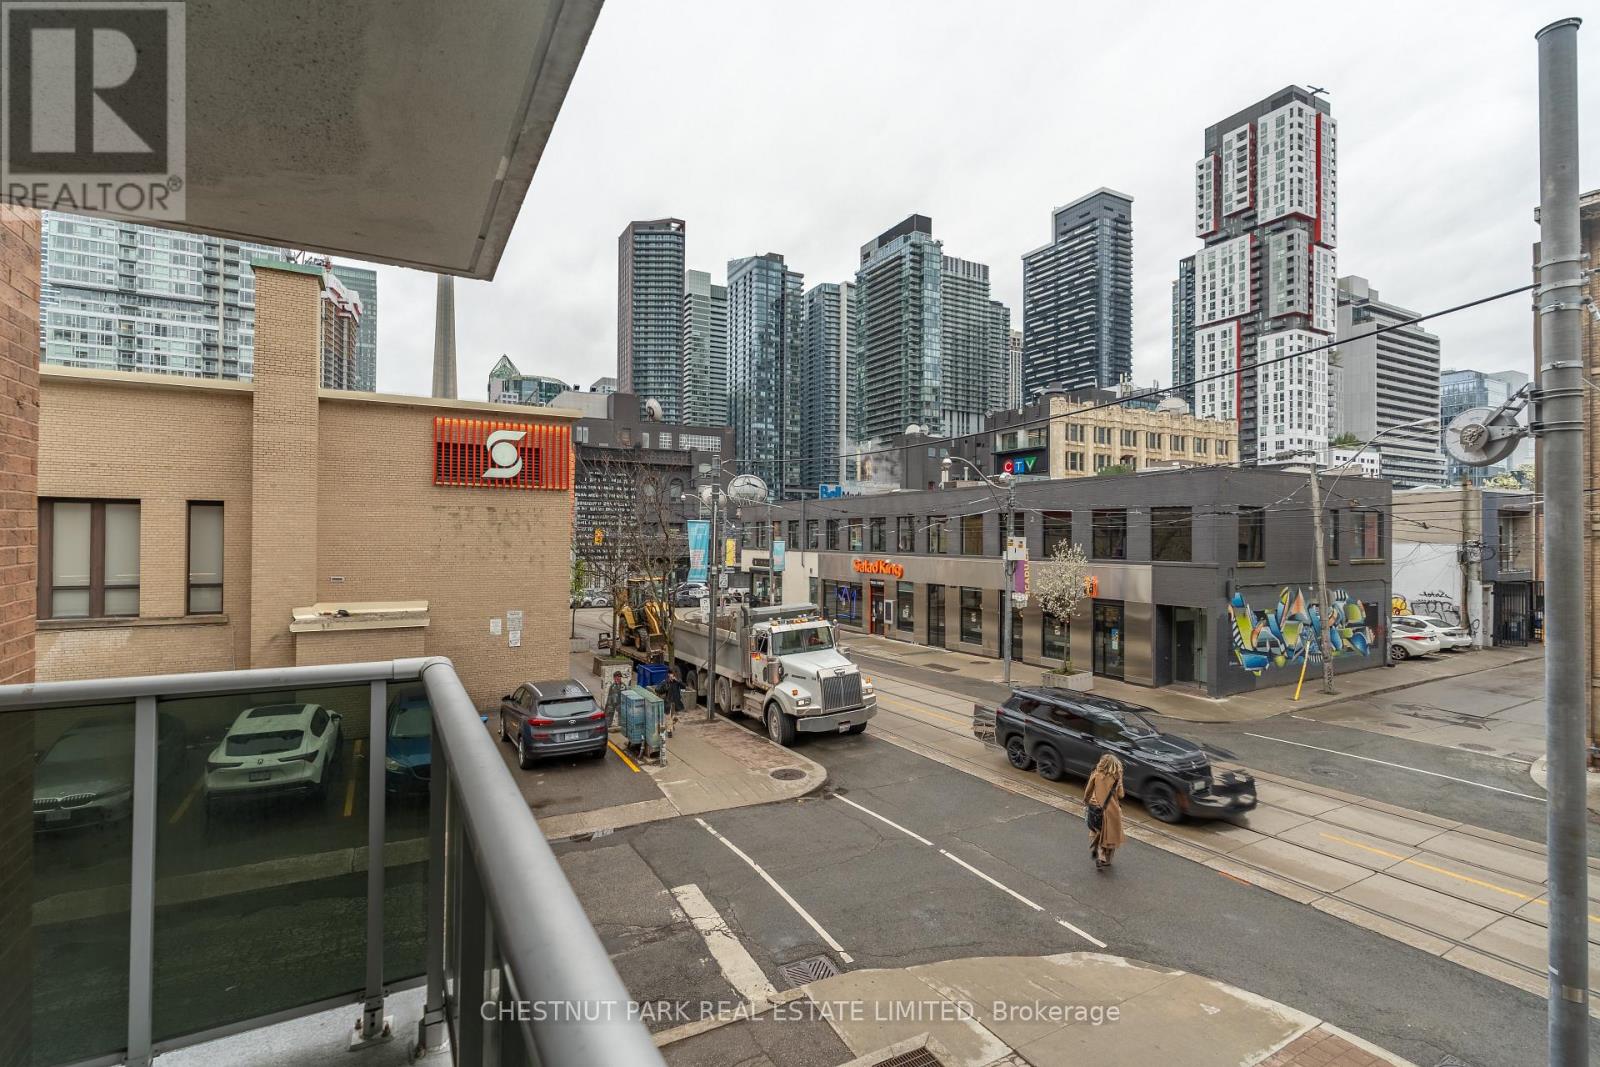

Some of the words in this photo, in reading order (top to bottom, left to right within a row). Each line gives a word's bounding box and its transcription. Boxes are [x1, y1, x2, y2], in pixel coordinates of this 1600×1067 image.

[1004, 457, 1036, 473] CTV
[820, 484, 842, 498] Bell
[853, 559, 880, 574] Salad
[879, 560, 904, 579] King
